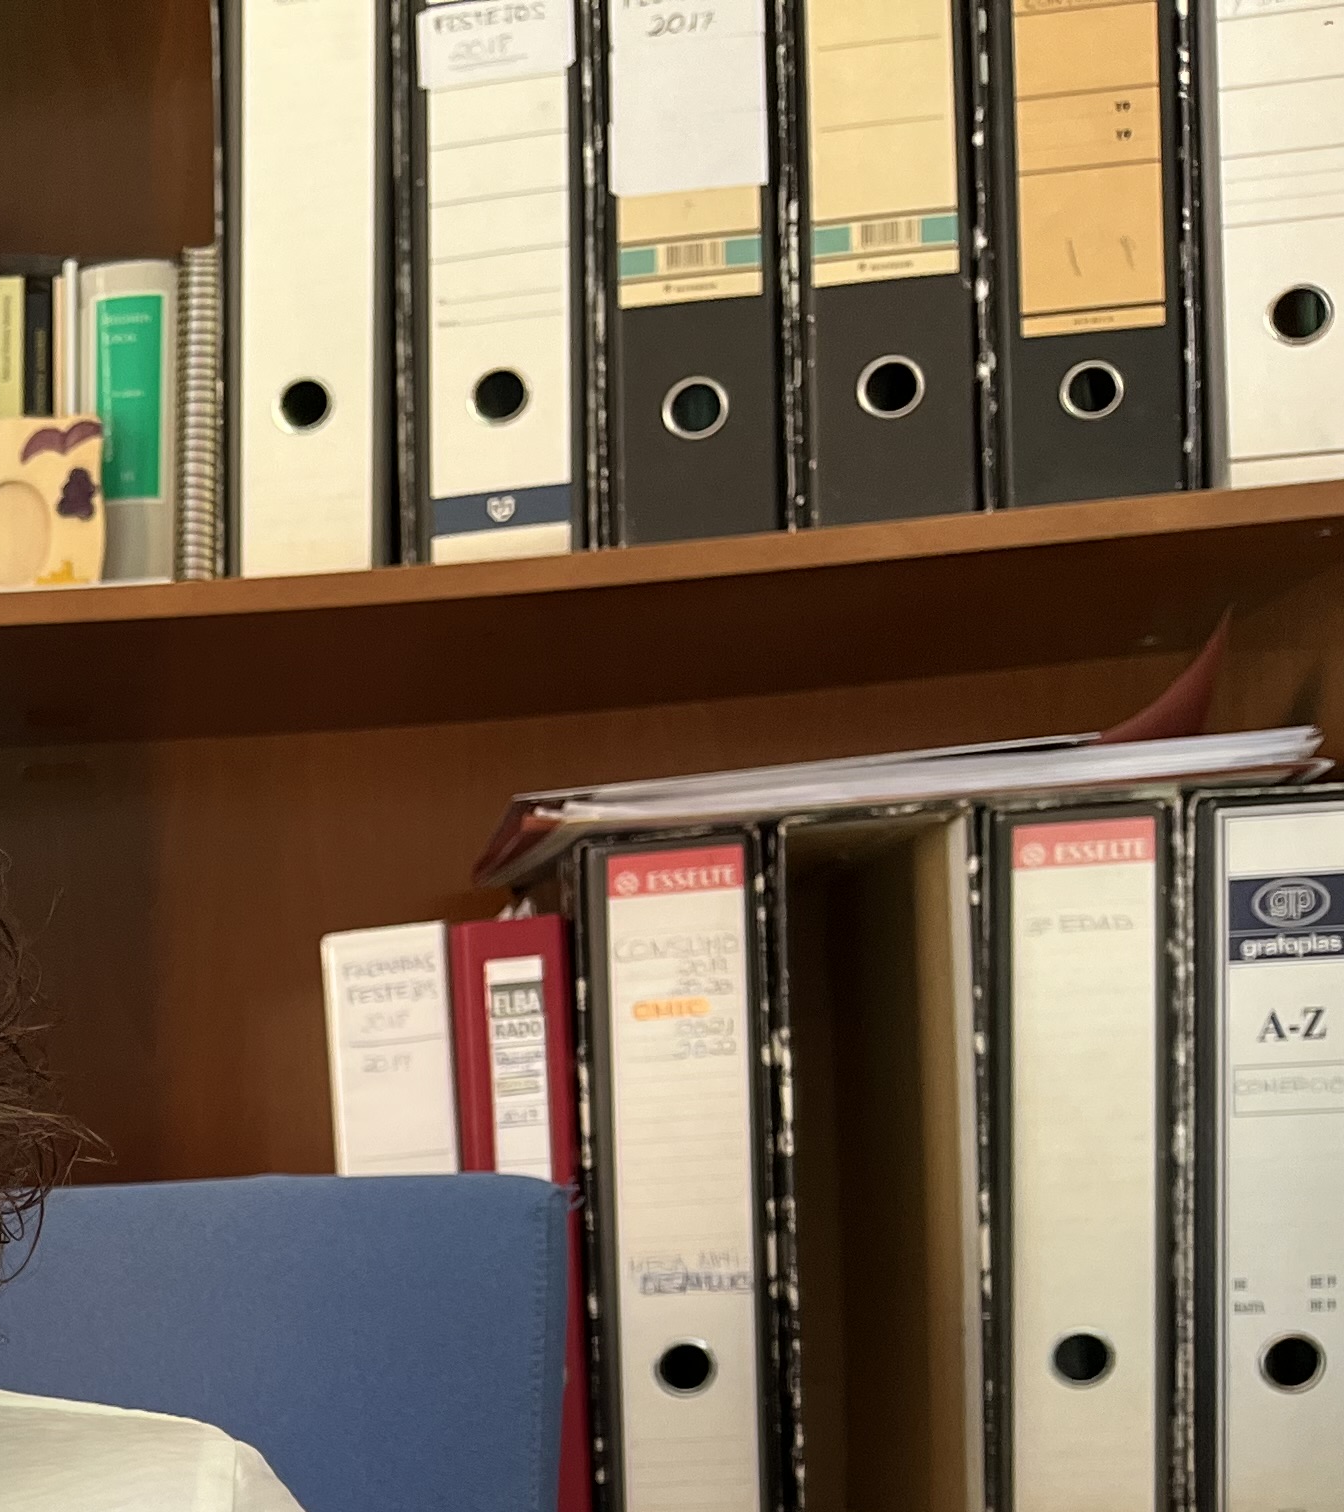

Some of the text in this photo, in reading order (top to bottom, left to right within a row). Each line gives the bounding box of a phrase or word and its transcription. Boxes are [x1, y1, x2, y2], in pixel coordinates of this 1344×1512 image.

[1054, 838, 1146, 863] ESSELTE
[646, 864, 736, 891] ESSELTE
[1240, 933, 1343, 960] grafoplas
[1257, 1006, 1328, 1043] A-Z
